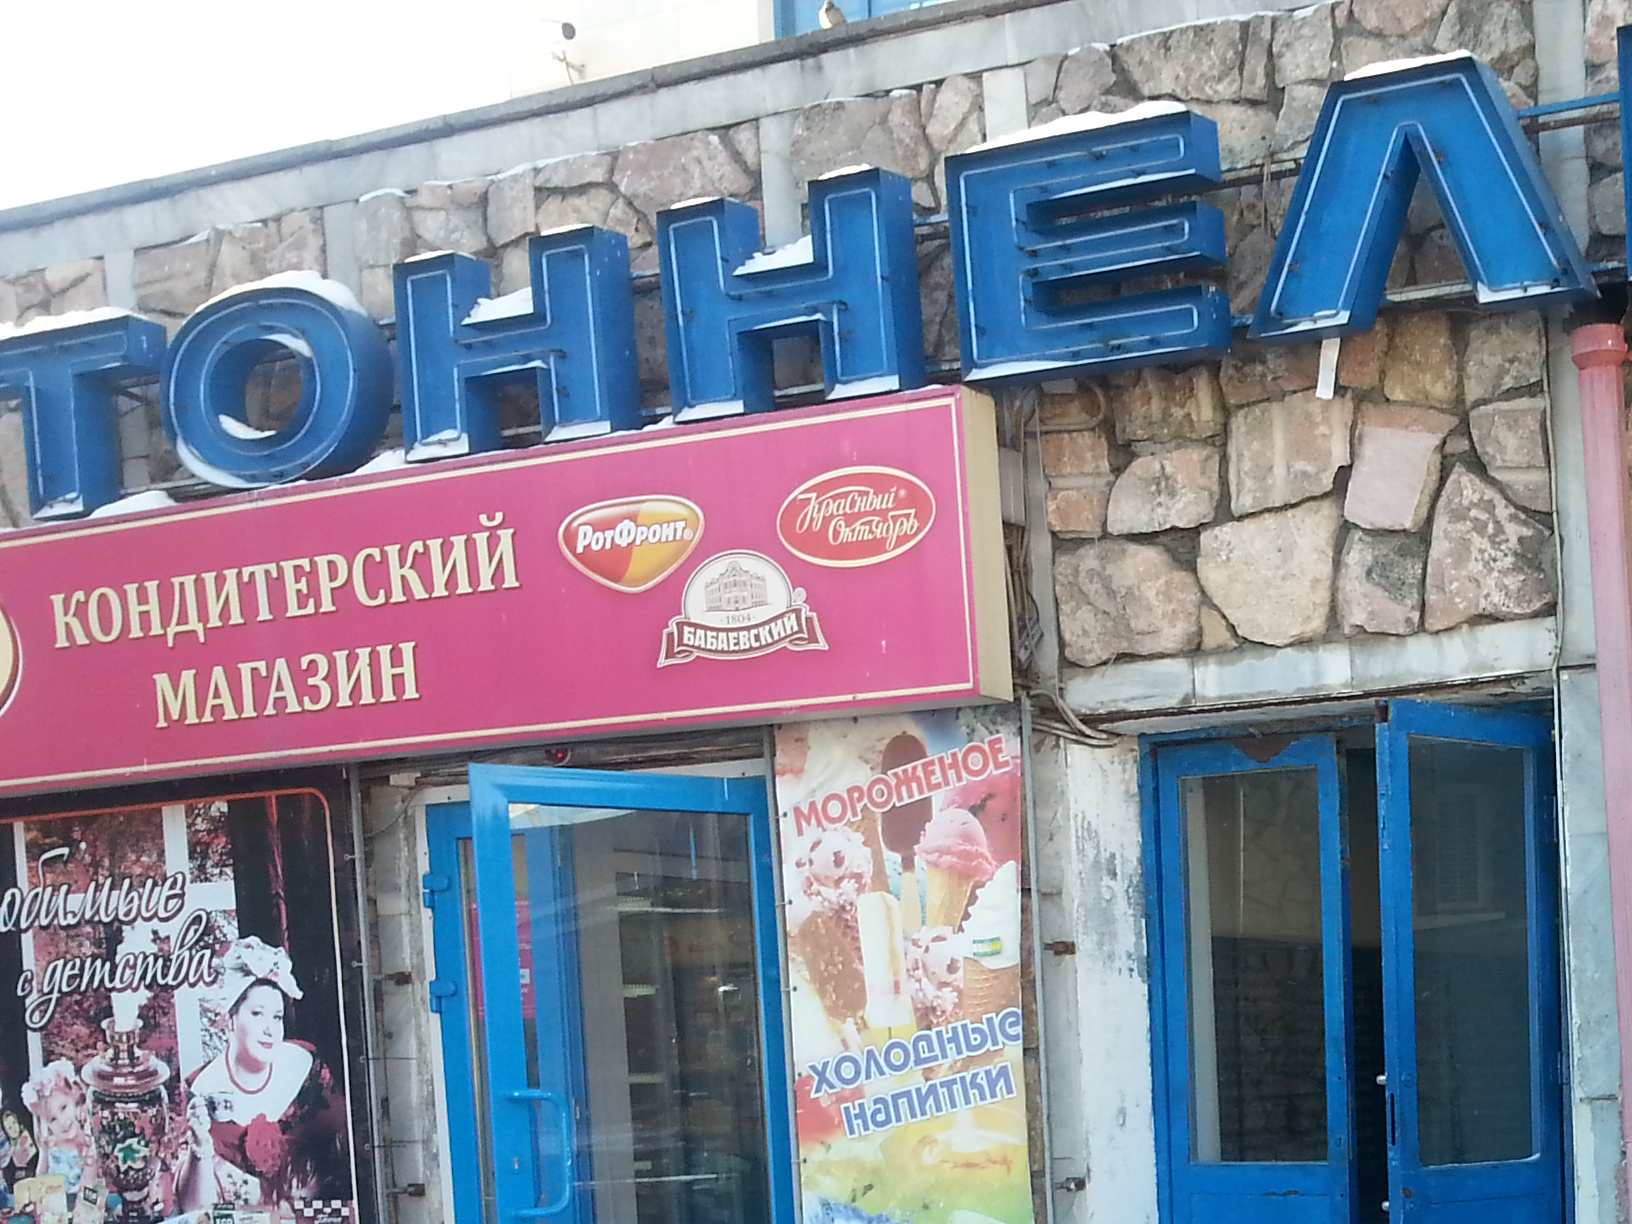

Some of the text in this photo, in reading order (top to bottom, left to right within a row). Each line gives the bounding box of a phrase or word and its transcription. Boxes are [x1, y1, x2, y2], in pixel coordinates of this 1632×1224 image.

[797, 484, 897, 534] Красный
[828, 508, 920, 551] Октябрь
[51, 511, 520, 650] КОНДИТЕРСКИЙ
[683, 611, 800, 651] БАБАЕВСКИЙ
[154, 640, 421, 729] МАГАЗИН
[792, 736, 1012, 837] МОРОЖЕНОЕ
[16, 908, 218, 1029] с детства
